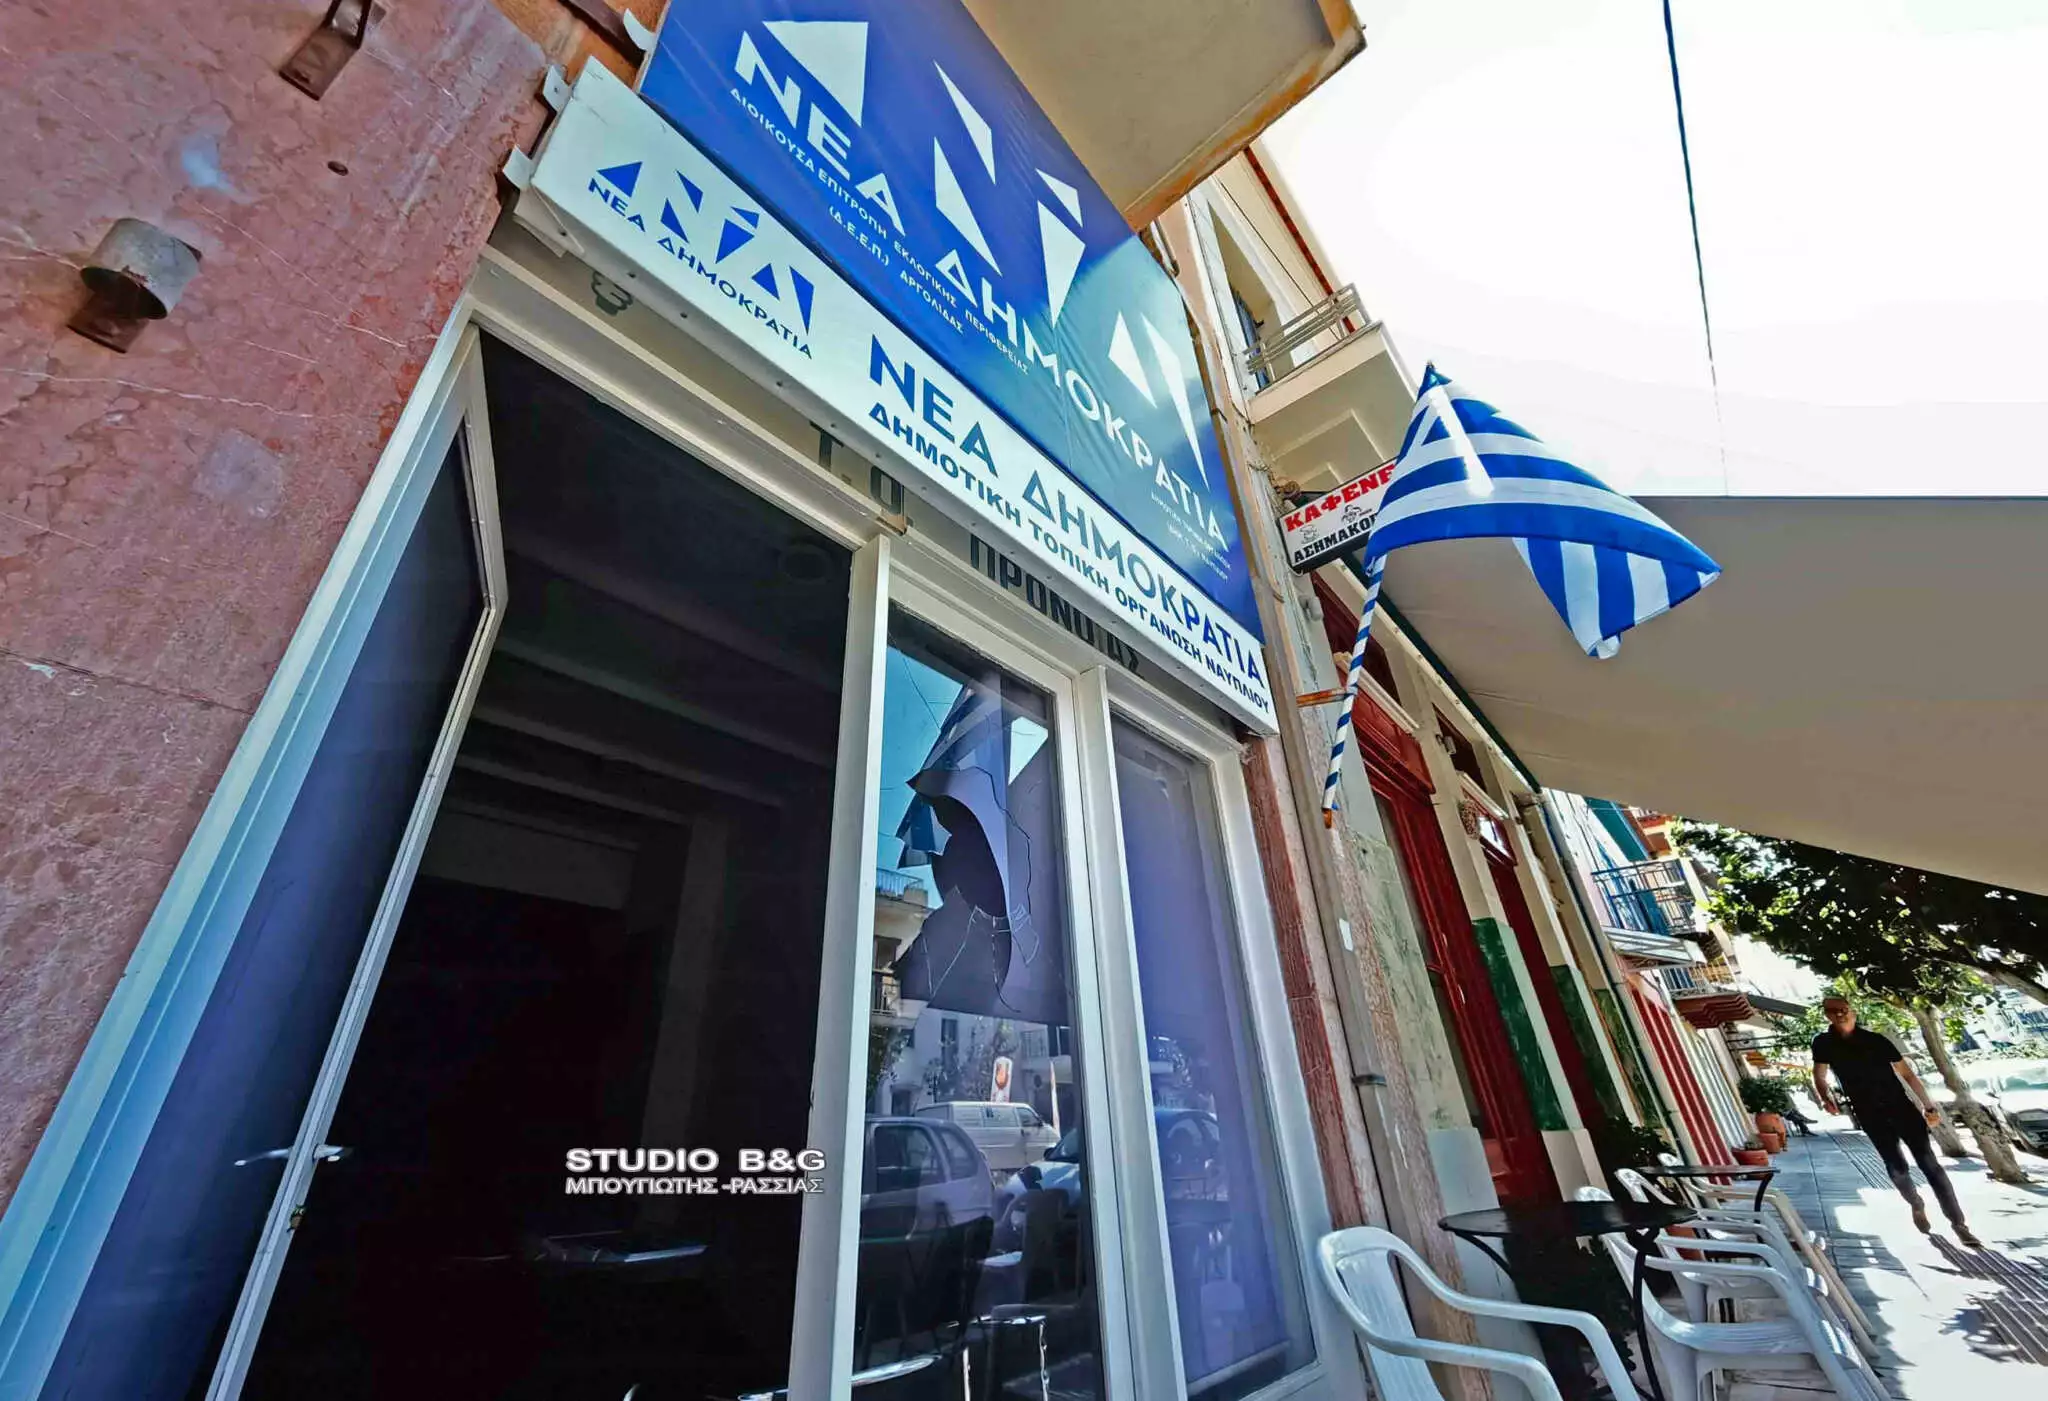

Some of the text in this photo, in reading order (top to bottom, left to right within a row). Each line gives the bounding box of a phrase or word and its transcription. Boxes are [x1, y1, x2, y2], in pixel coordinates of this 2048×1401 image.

[588, 177, 812, 360] ΝΕΑ ΔΗΜΟΚΡΑΤΙΑ
[730, 88, 815, 173] ΔΙΟΙΚΟΥΣΑ
[818, 167, 888, 239] ΕΠΙΤΡΟΠΗ
[894, 241, 957, 308] ΕΚΛΟΓΙΚΗΣ
[734, 30, 1229, 552] ΝΕΑ ΔΗΜΟΚΡΑΤΙΑ
[900, 270, 964, 334] ΑΡΓΟΛΙΔΑΣ
[868, 402, 1021, 529] ΔΗΜΟΤΙΚΗ
[1028, 517, 1110, 594] ΤΟΠΙΚΗ
[1115, 586, 1202, 664] ΟΡΓΑΝΩΣΗ
[1205, 654, 1269, 714] ΝΑΥΠΛΙΟΥ
[869, 333, 999, 479] ΝΕΑ
[1021, 469, 1265, 689] ΔΗΜΟΚΡΑΤΙΑ
